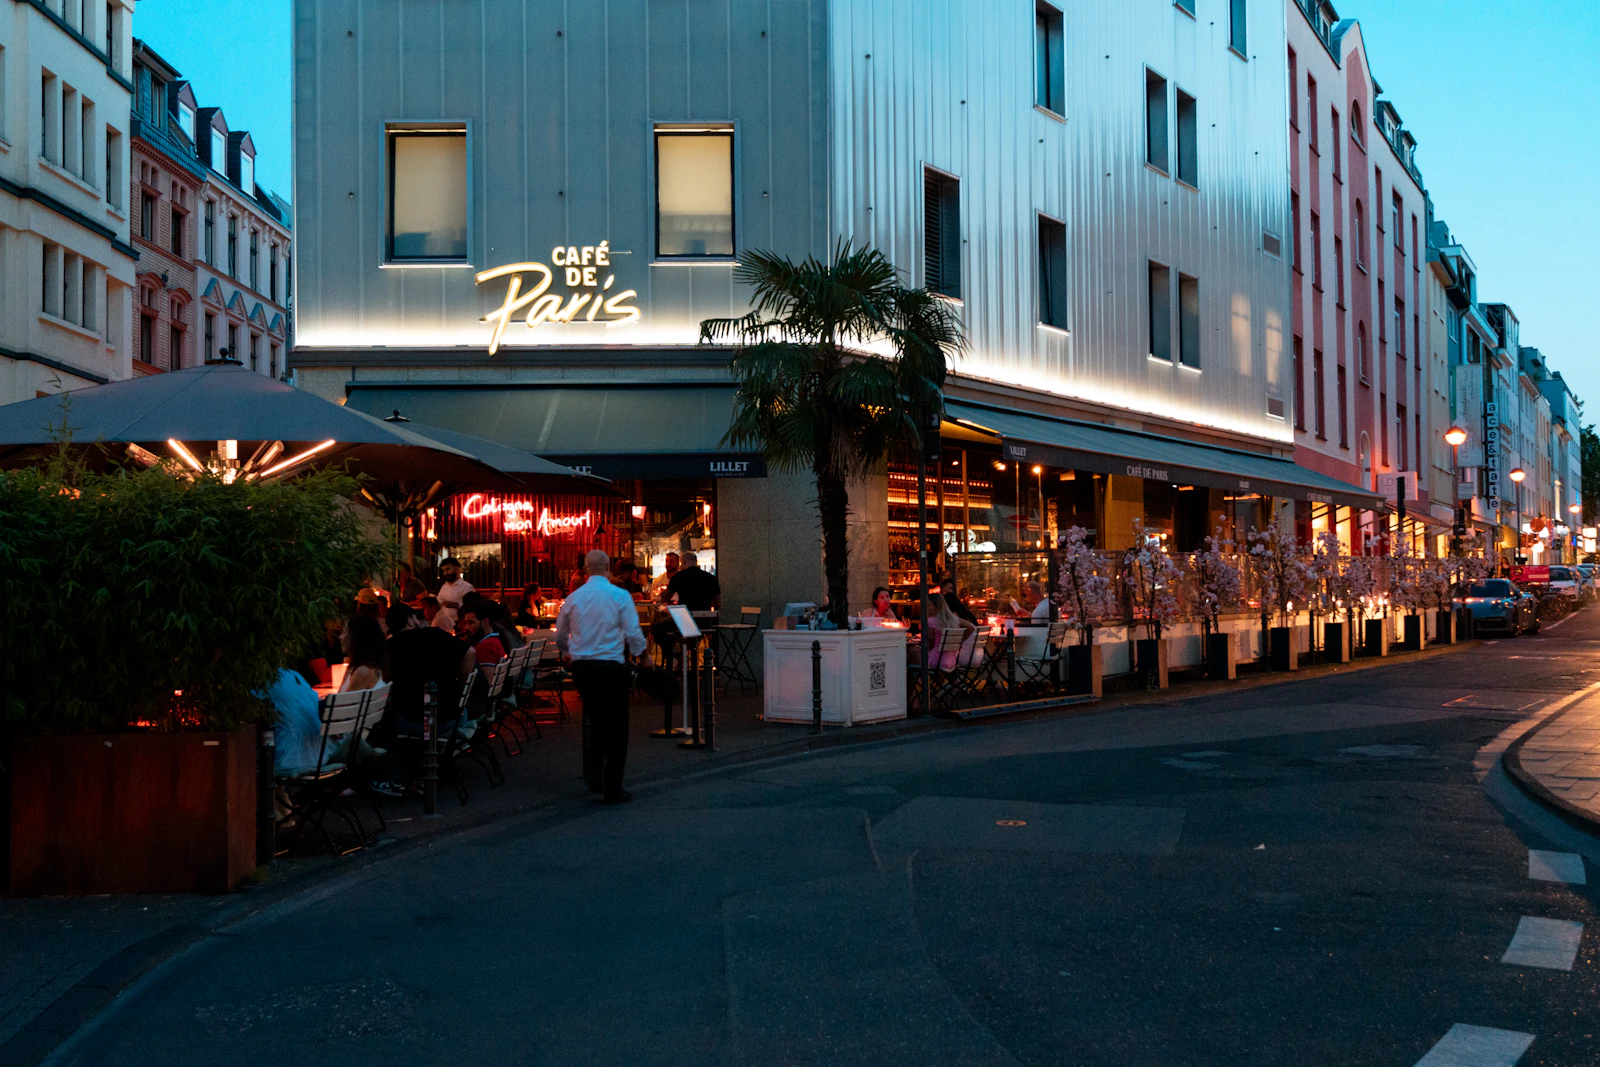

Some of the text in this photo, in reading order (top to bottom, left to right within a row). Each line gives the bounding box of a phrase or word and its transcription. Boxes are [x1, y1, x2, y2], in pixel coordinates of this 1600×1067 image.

[551, 240, 610, 267] CAFÉ
[565, 266, 598, 287] DE
[474, 261, 642, 357] Paris
[1009, 445, 1027, 457] LILLET
[1488, 403, 1499, 508] ace&tate
[709, 461, 750, 472] LILLET
[1126, 464, 1169, 481] CAFÉ DE PARIS
[504, 507, 591, 536] mon Amour!
